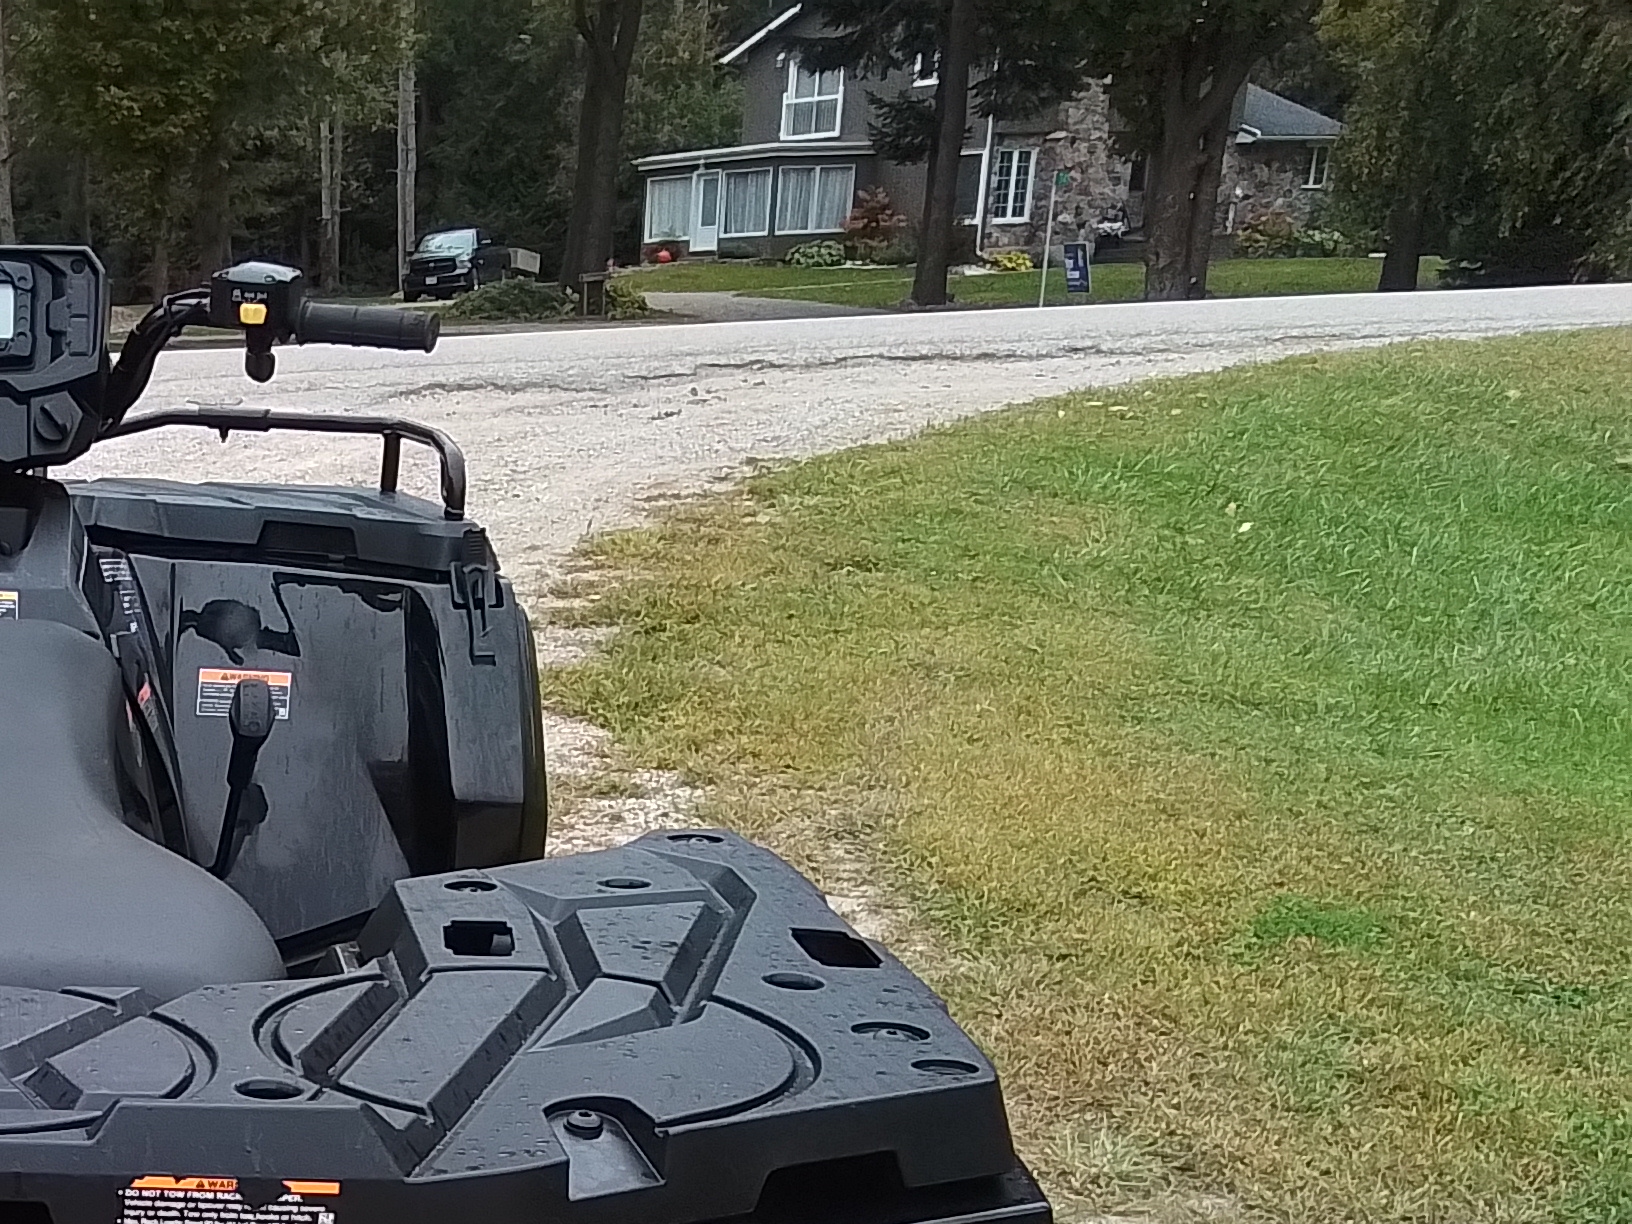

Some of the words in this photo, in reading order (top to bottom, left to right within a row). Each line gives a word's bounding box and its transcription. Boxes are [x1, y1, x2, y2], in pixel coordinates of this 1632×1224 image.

[208, 1180, 237, 1188] WAR
[125, 1189, 139, 1197] DO
[141, 1190, 162, 1198] NOT
[164, 1190, 185, 1198] TOW
[187, 1191, 215, 1199] FROM
